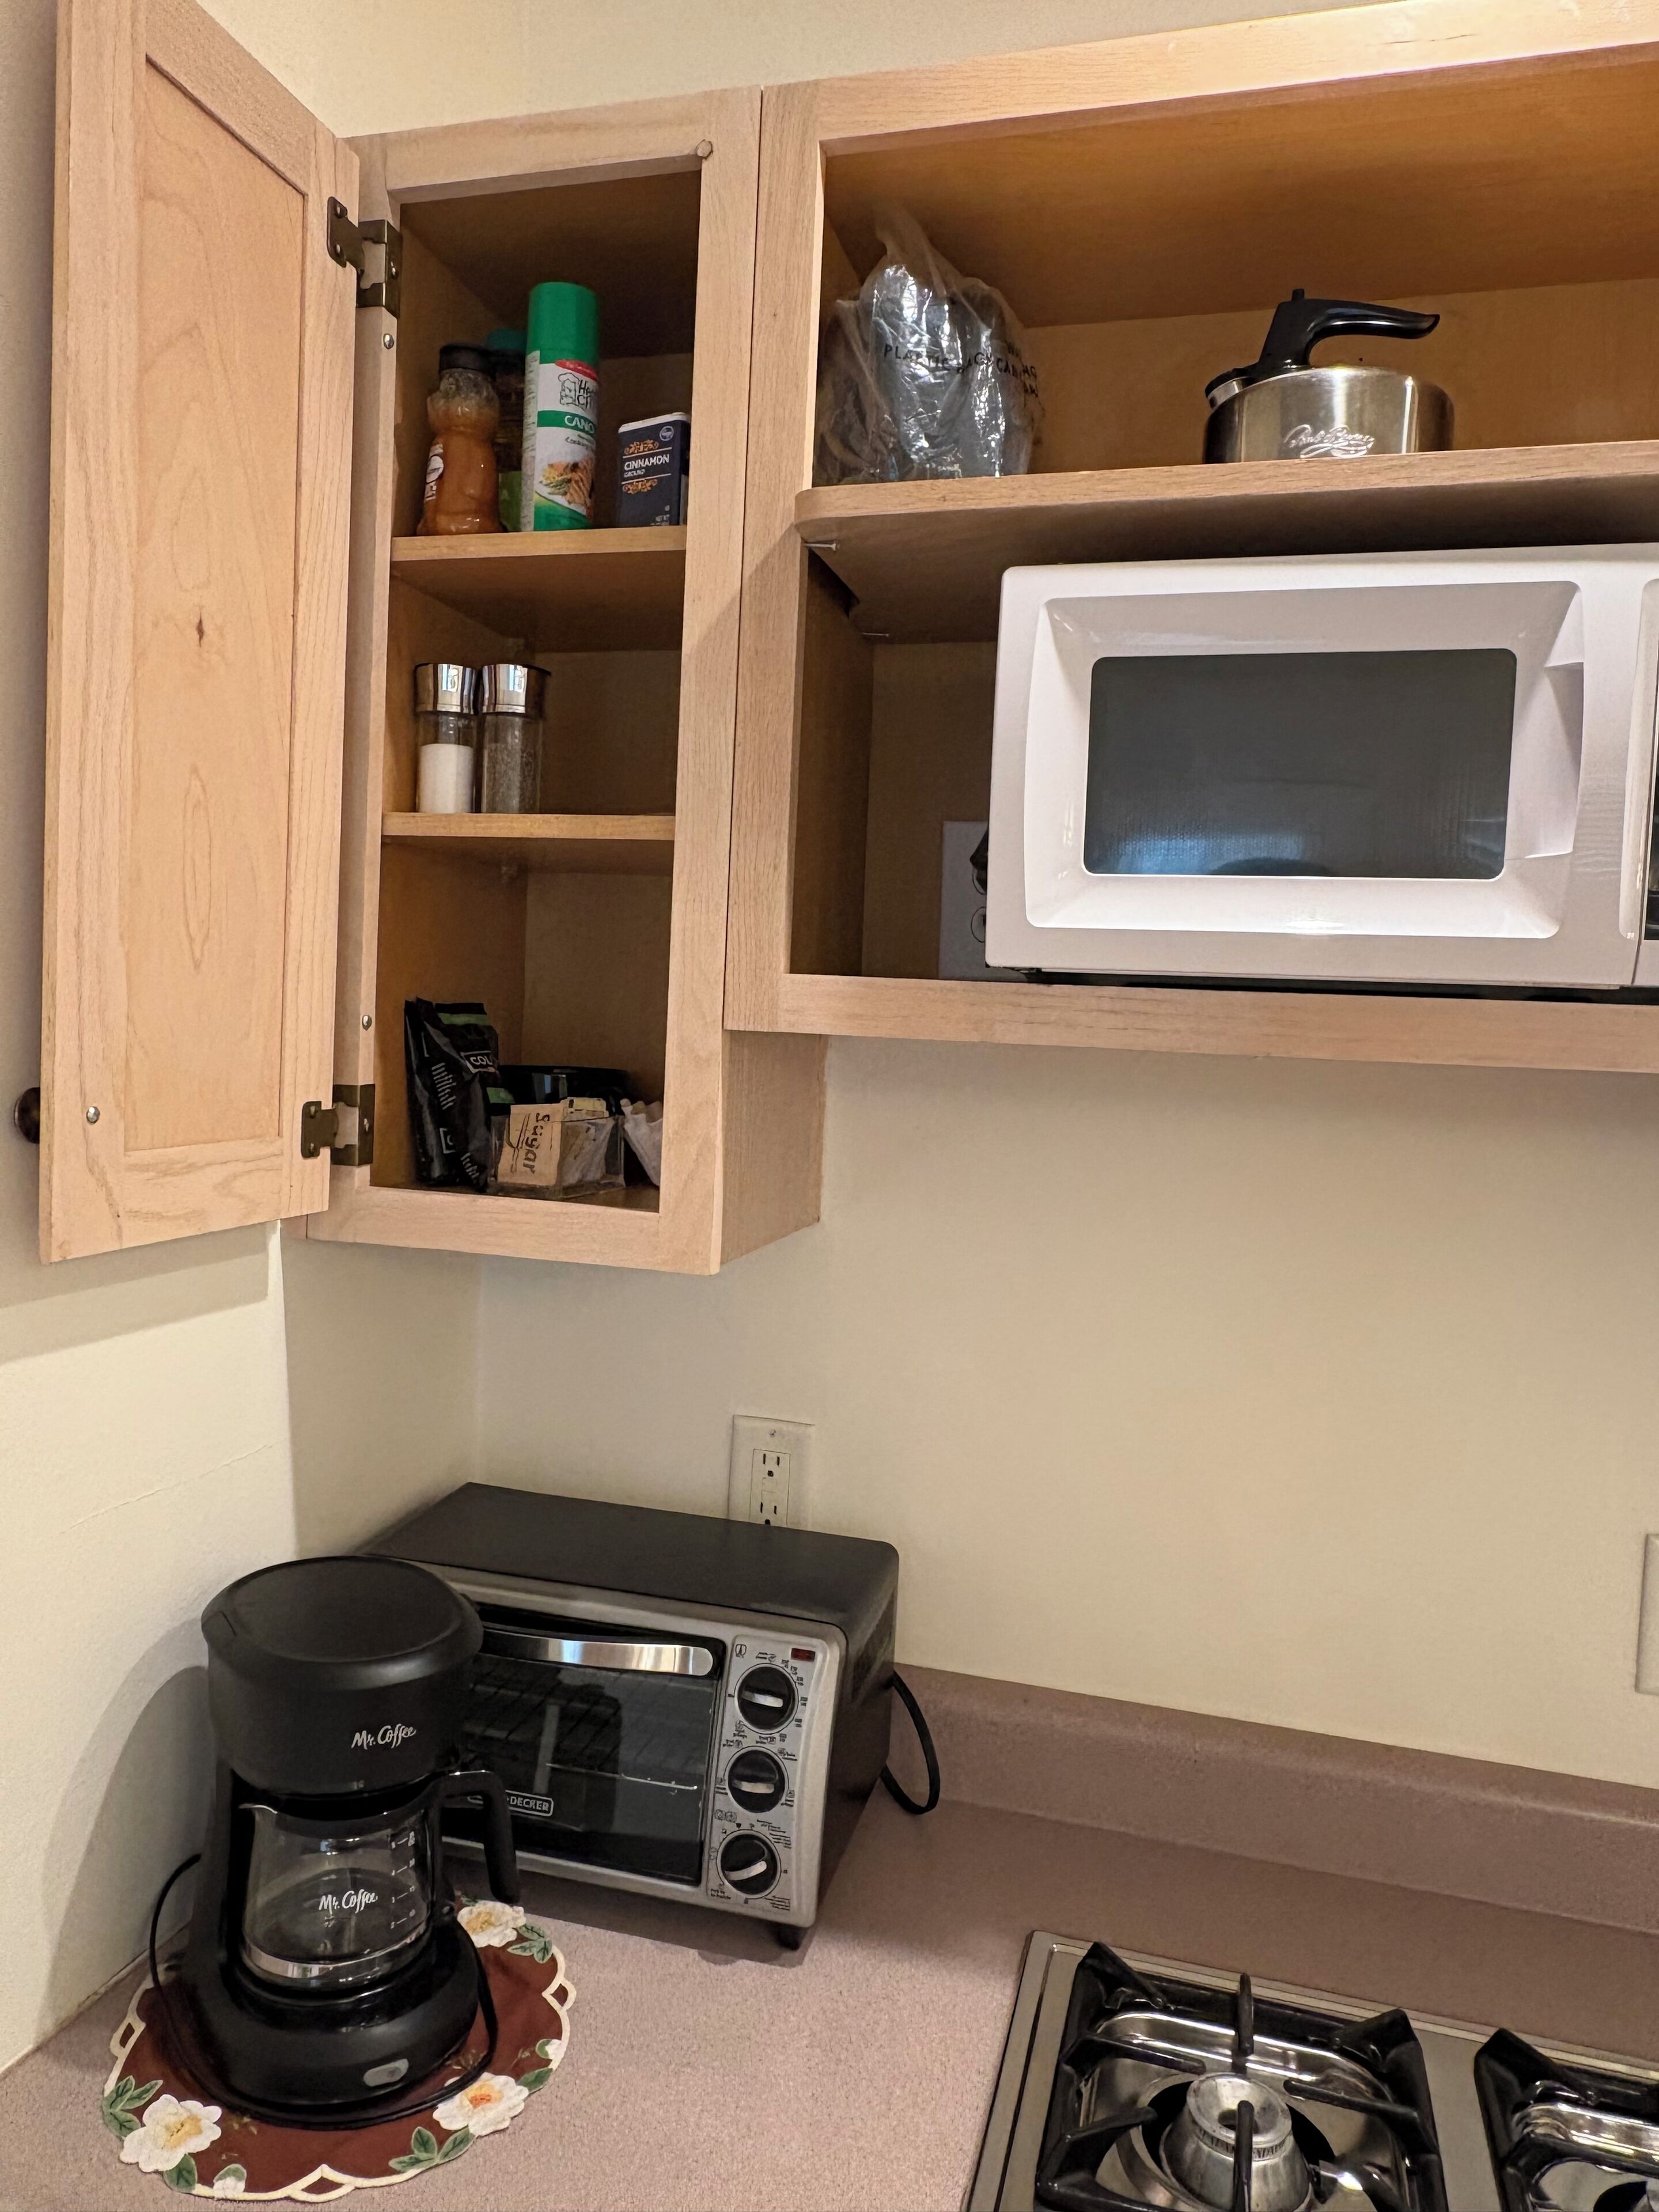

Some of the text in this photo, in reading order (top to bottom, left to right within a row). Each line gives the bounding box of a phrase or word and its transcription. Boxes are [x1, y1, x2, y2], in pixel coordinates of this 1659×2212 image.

[624, 454, 669, 471] CINNAMON
[351, 1724, 416, 1750] Mr. Coffee
[318, 1889, 378, 1915] Mr. Coffee
